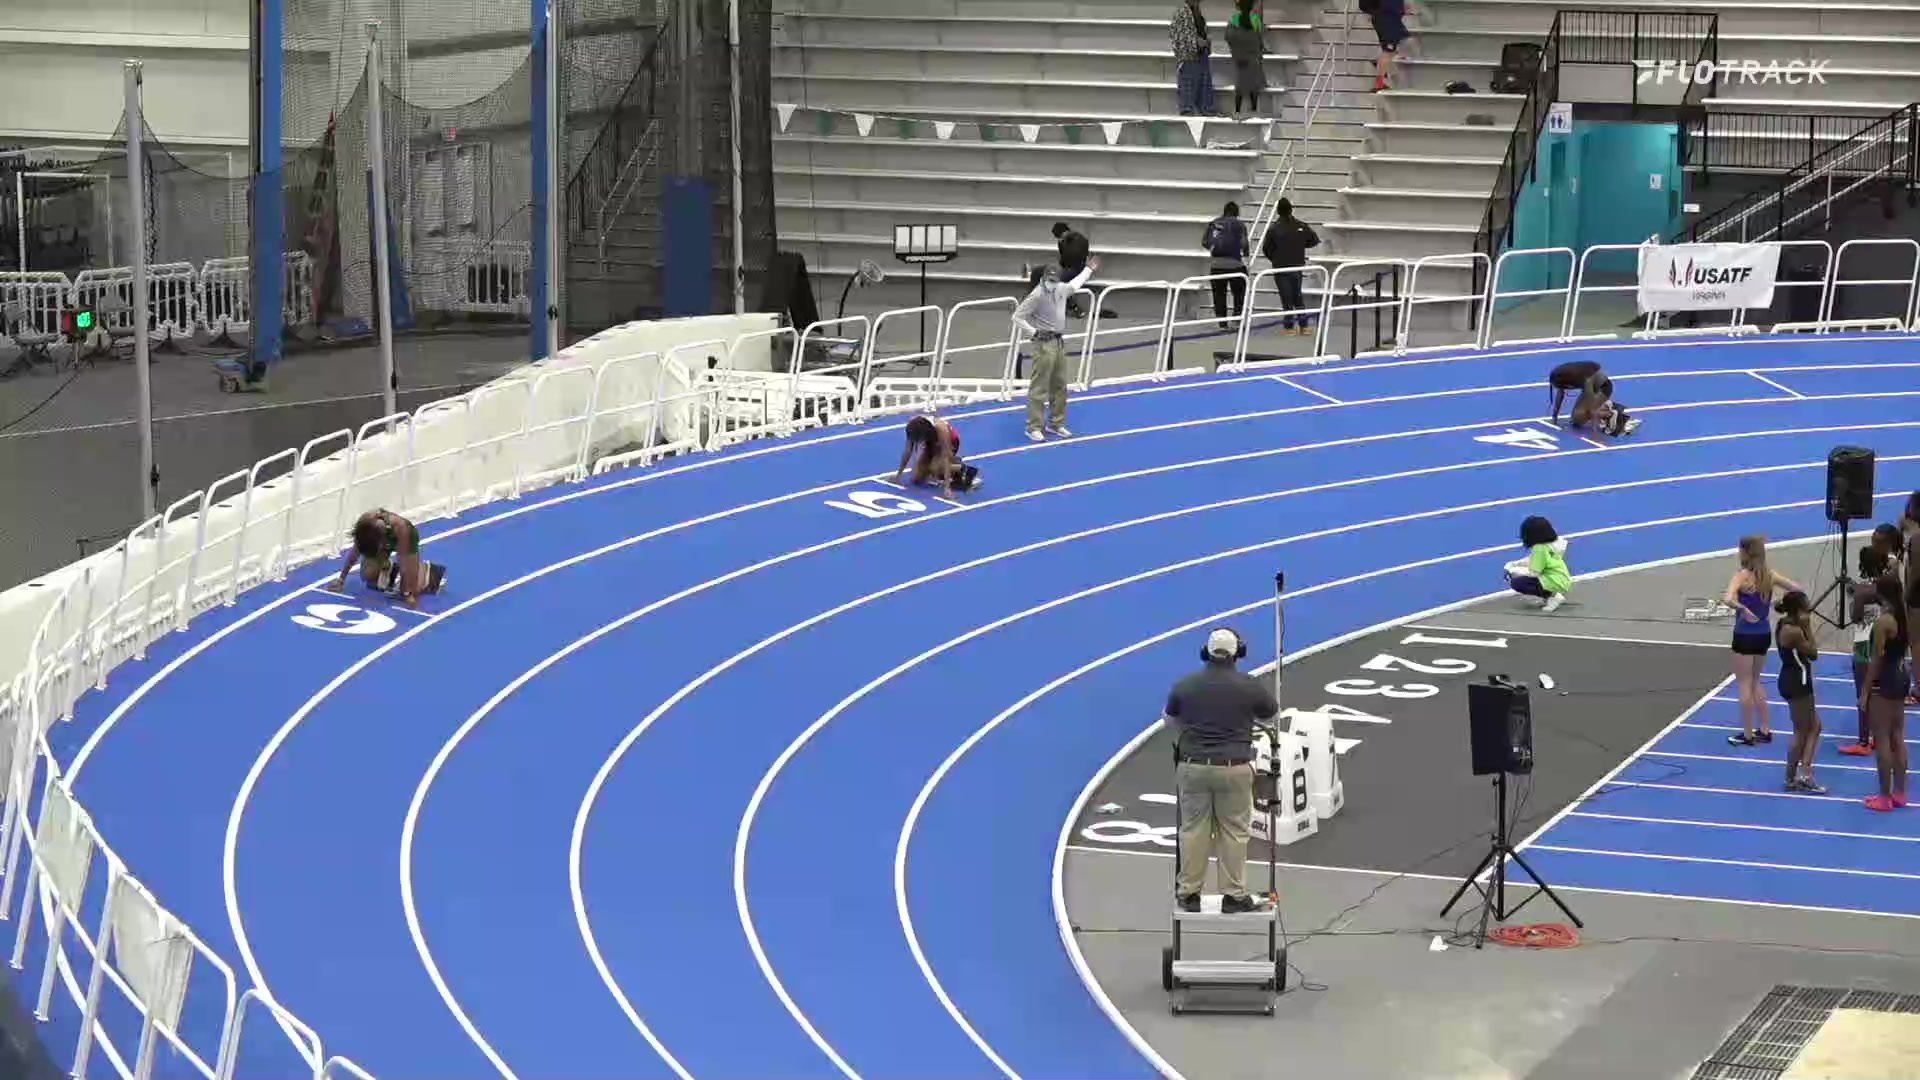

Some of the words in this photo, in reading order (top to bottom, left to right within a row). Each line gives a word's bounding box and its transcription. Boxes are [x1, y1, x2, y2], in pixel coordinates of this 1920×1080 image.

[1694, 267, 1752, 284] USATF
[1473, 427, 1560, 450] 4
[824, 491, 927, 519] 5
[291, 604, 397, 634] 6
[1400, 633, 1508, 648] 1
[1360, 653, 1477, 674] 2
[1324, 679, 1440, 698] 3
